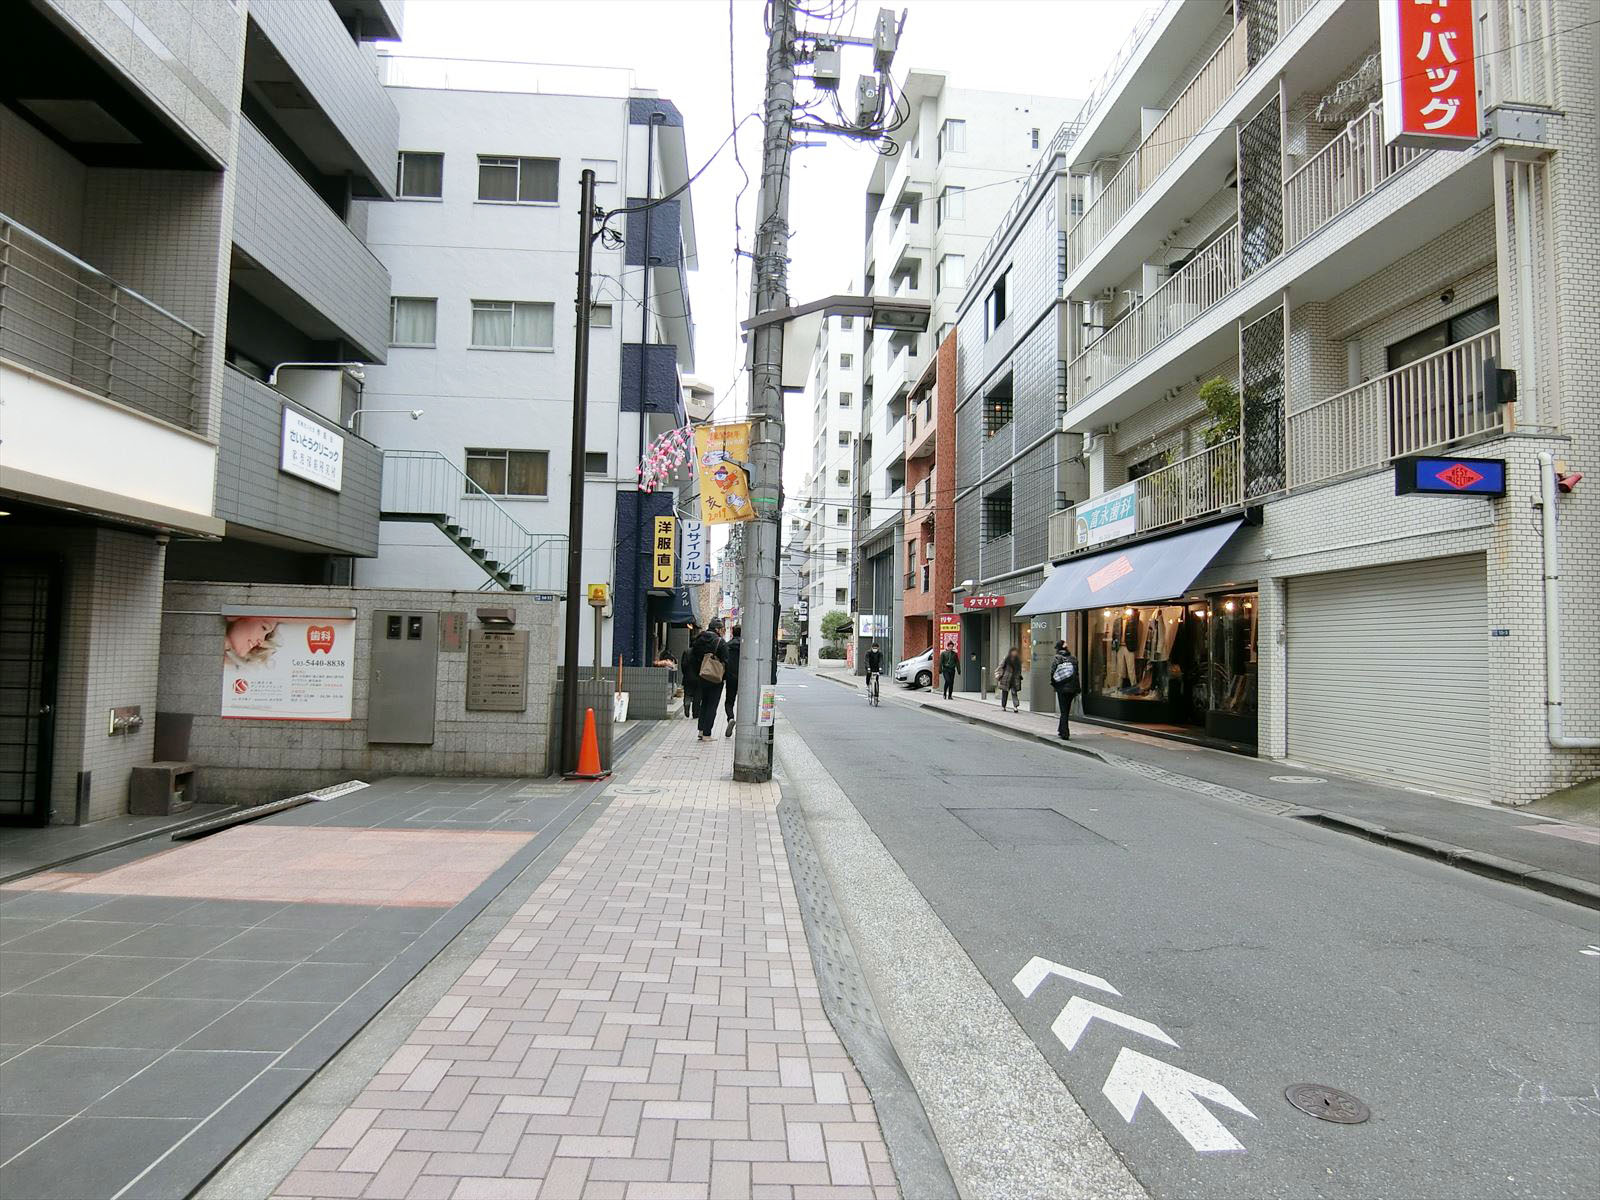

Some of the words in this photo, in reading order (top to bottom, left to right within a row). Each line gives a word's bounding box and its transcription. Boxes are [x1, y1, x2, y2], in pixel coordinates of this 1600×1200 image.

[289, 429, 339, 463] さいとうクリニック
[657, 521, 672, 583] 洋服直し
[686, 522, 701, 570] リサイクル
[969, 598, 998, 606] タマリヤ
[310, 629, 331, 641] 歯科
